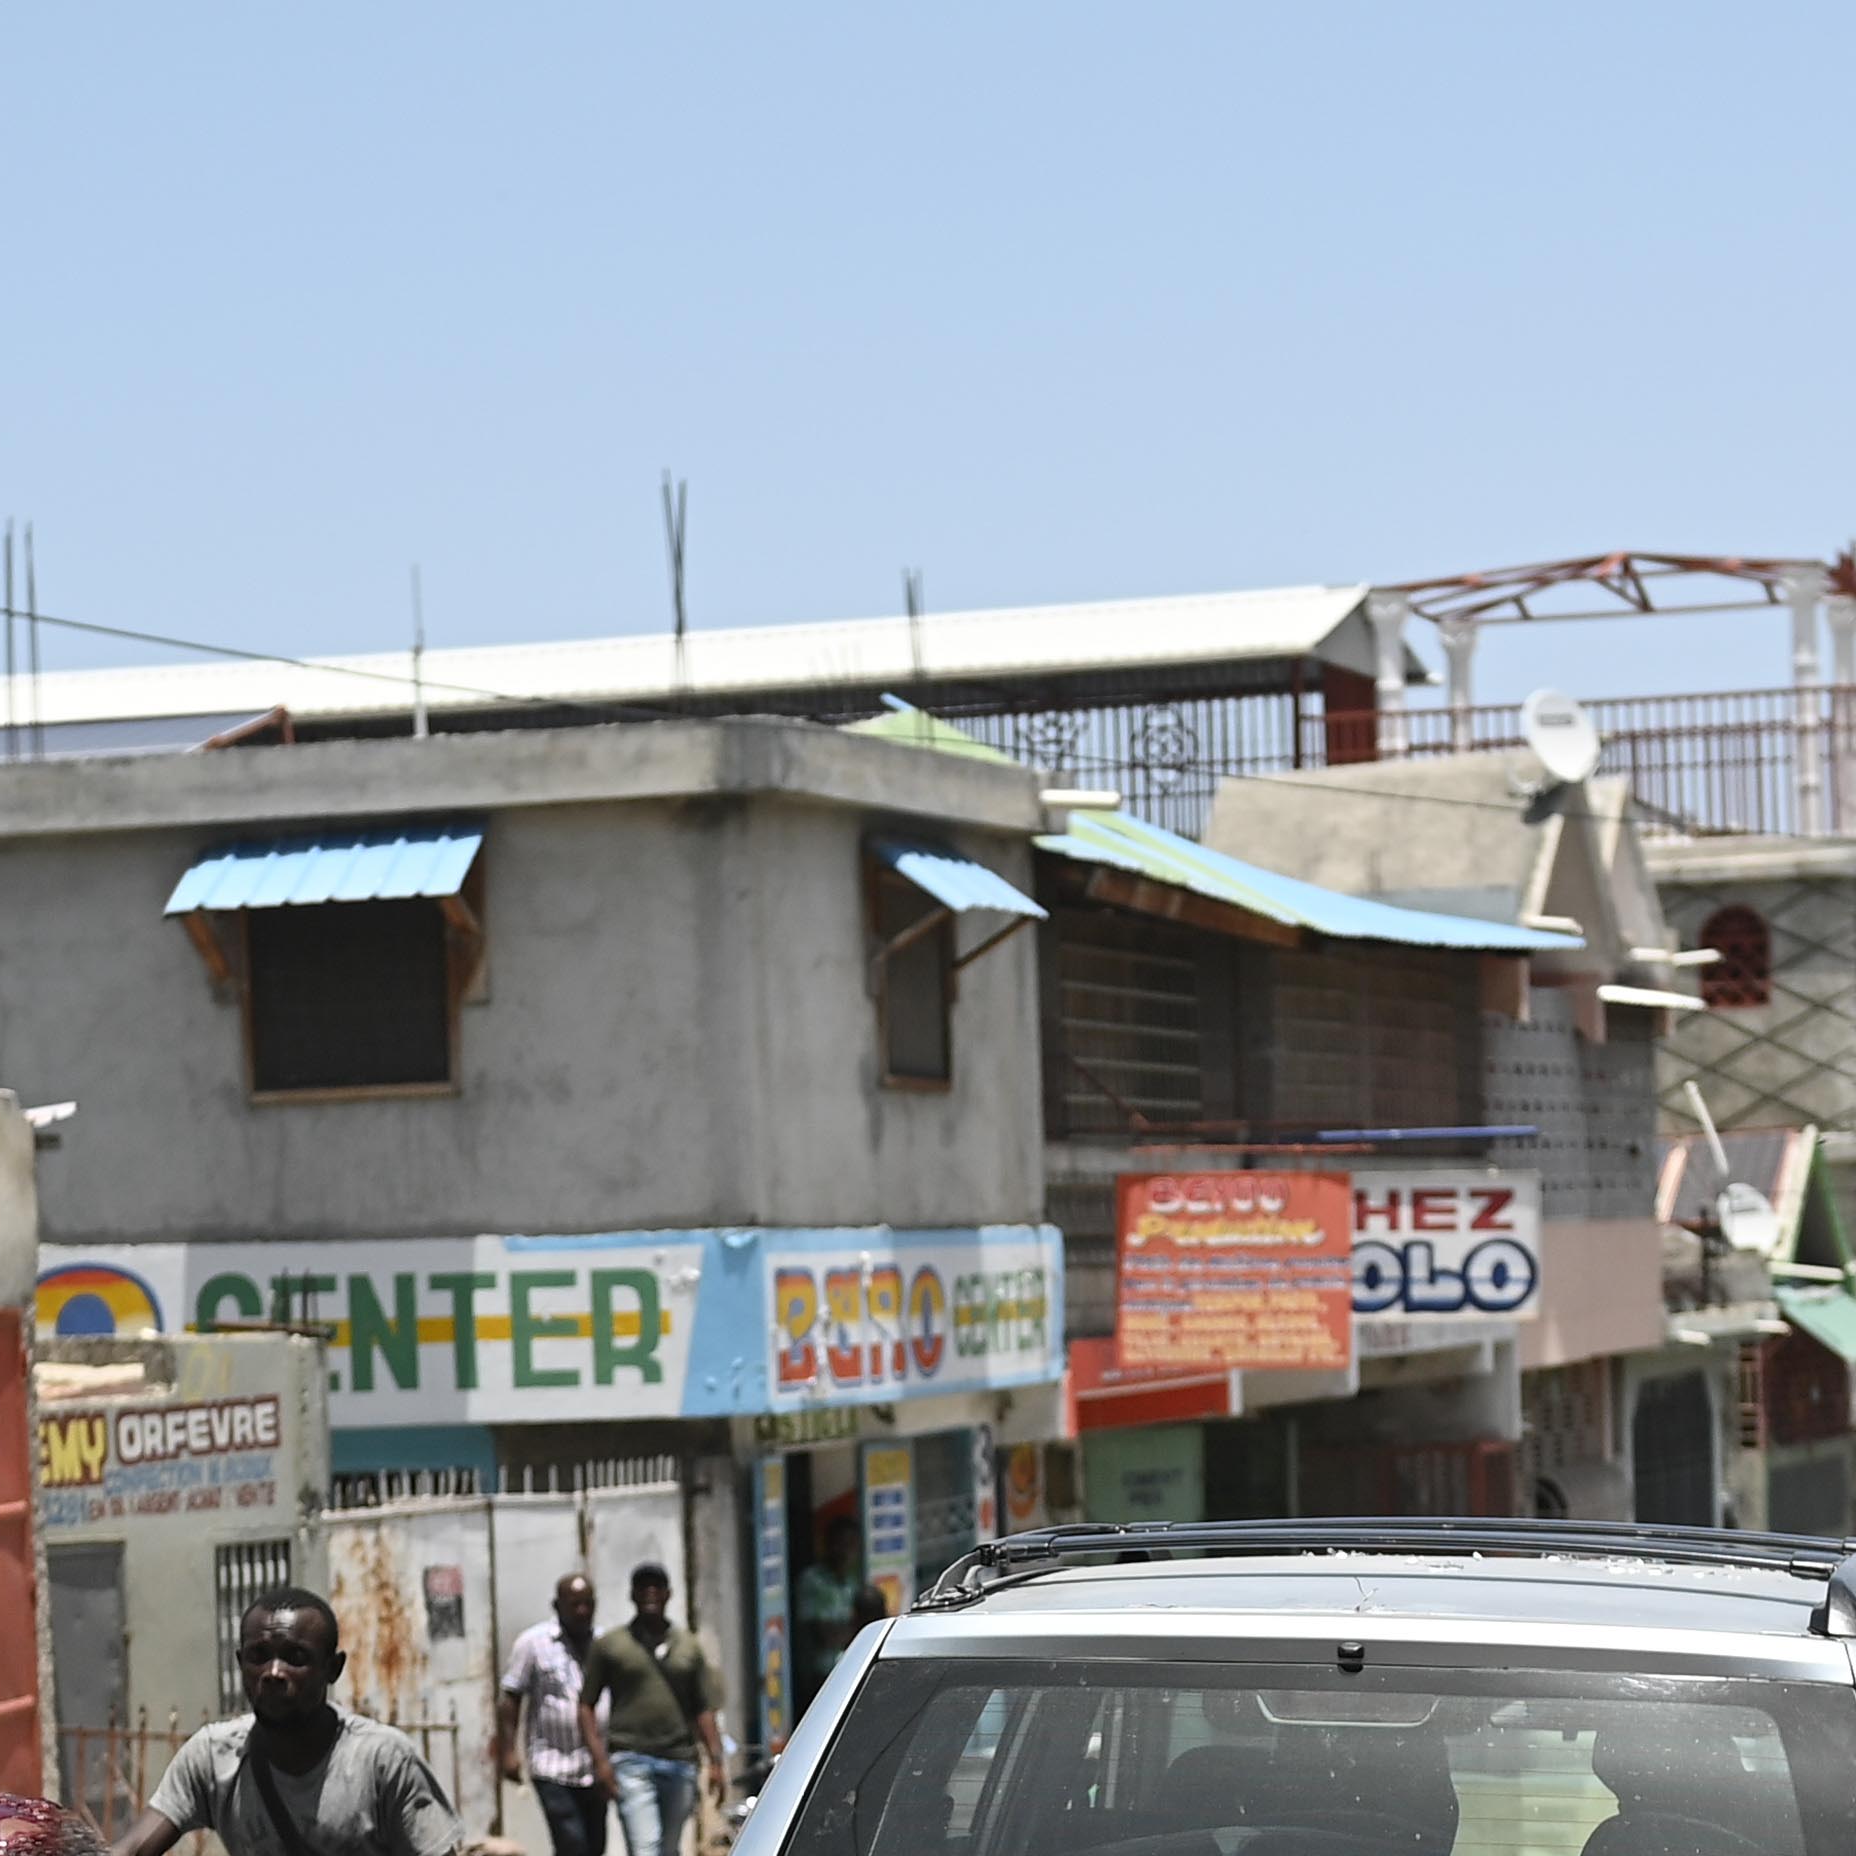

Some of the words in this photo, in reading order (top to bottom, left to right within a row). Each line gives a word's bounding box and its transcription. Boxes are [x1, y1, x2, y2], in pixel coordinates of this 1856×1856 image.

[1353, 1187, 1515, 1232] HEZ
[1351, 1238, 1538, 1313] OLO
[115, 1393, 281, 1466] ORFEVRE
